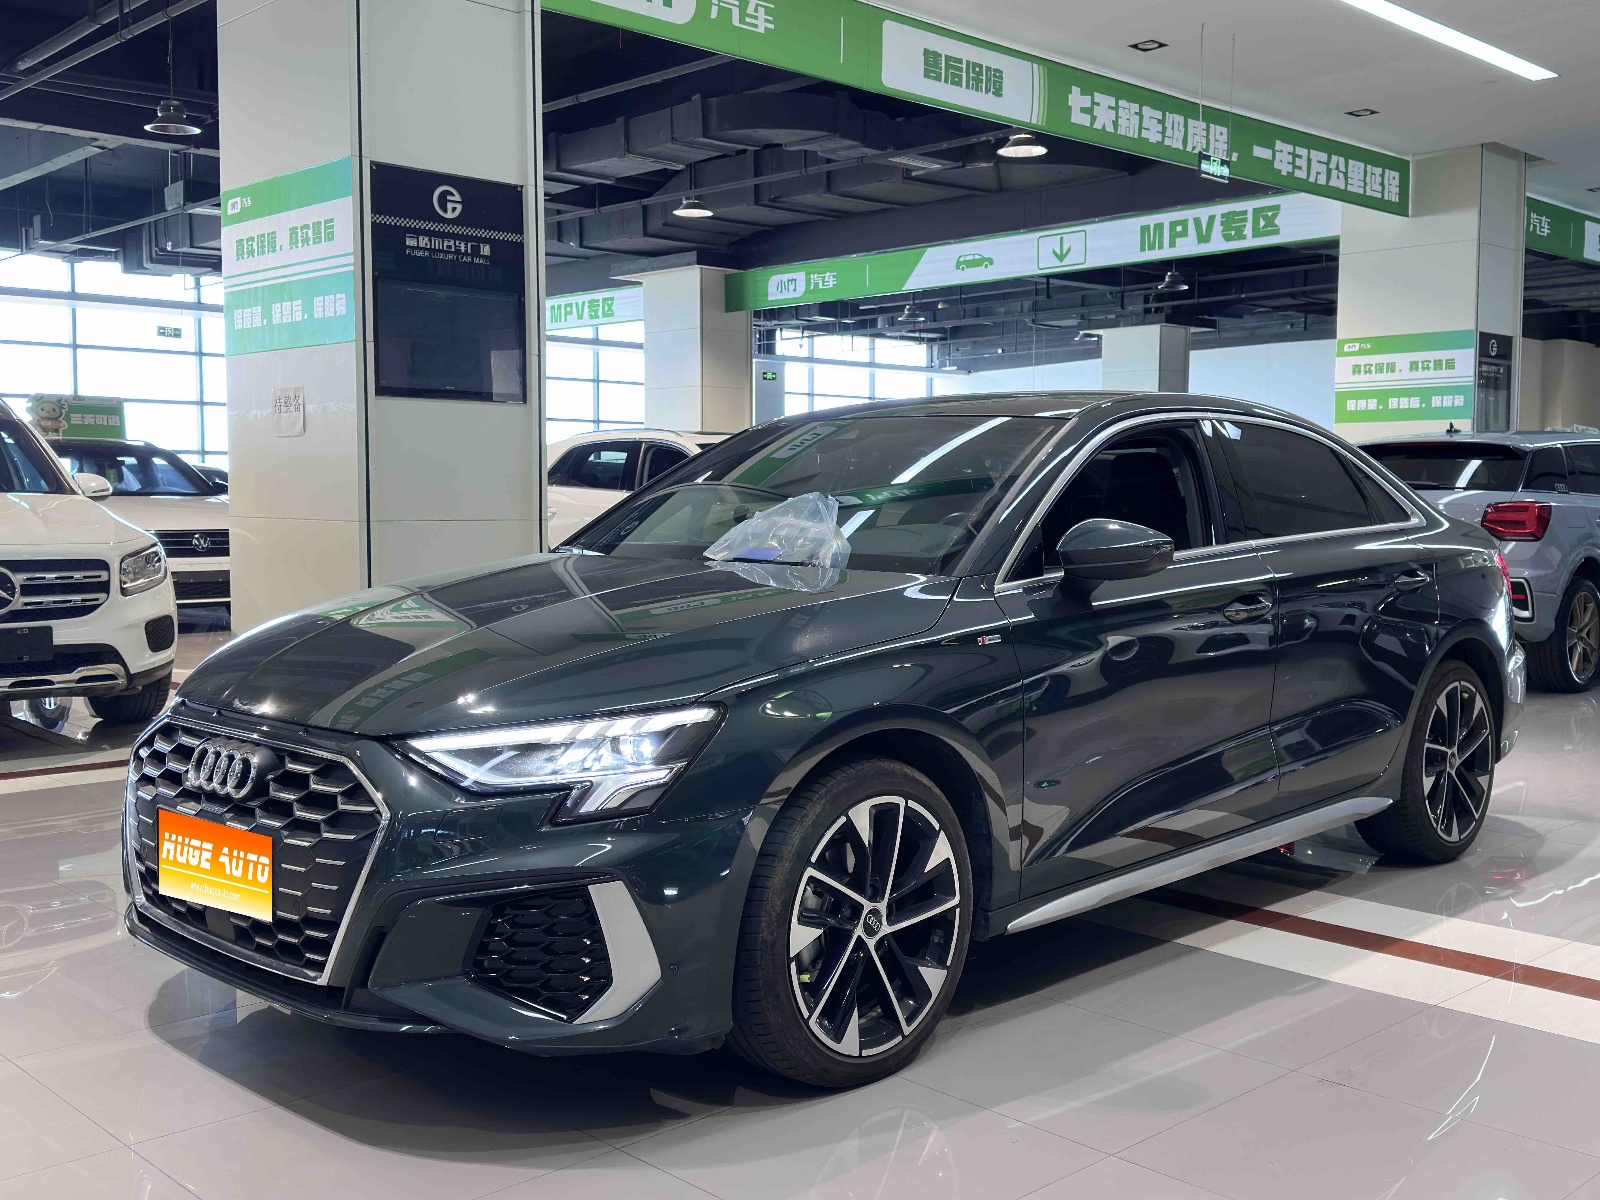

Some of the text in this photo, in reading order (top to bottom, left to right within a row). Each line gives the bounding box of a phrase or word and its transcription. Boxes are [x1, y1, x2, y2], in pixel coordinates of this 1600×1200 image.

[709, 0, 775, 34] 汽车
[922, 47, 1004, 98] 售后保障
[1139, 203, 1282, 253] MPV专区
[1529, 211, 1551, 237] 汽车
[405, 248, 491, 266] FUGER LUXURY CAR MALL
[810, 271, 838, 290] 汽车
[550, 296, 615, 324] MPV专区
[70, 413, 121, 426] 三天可退
